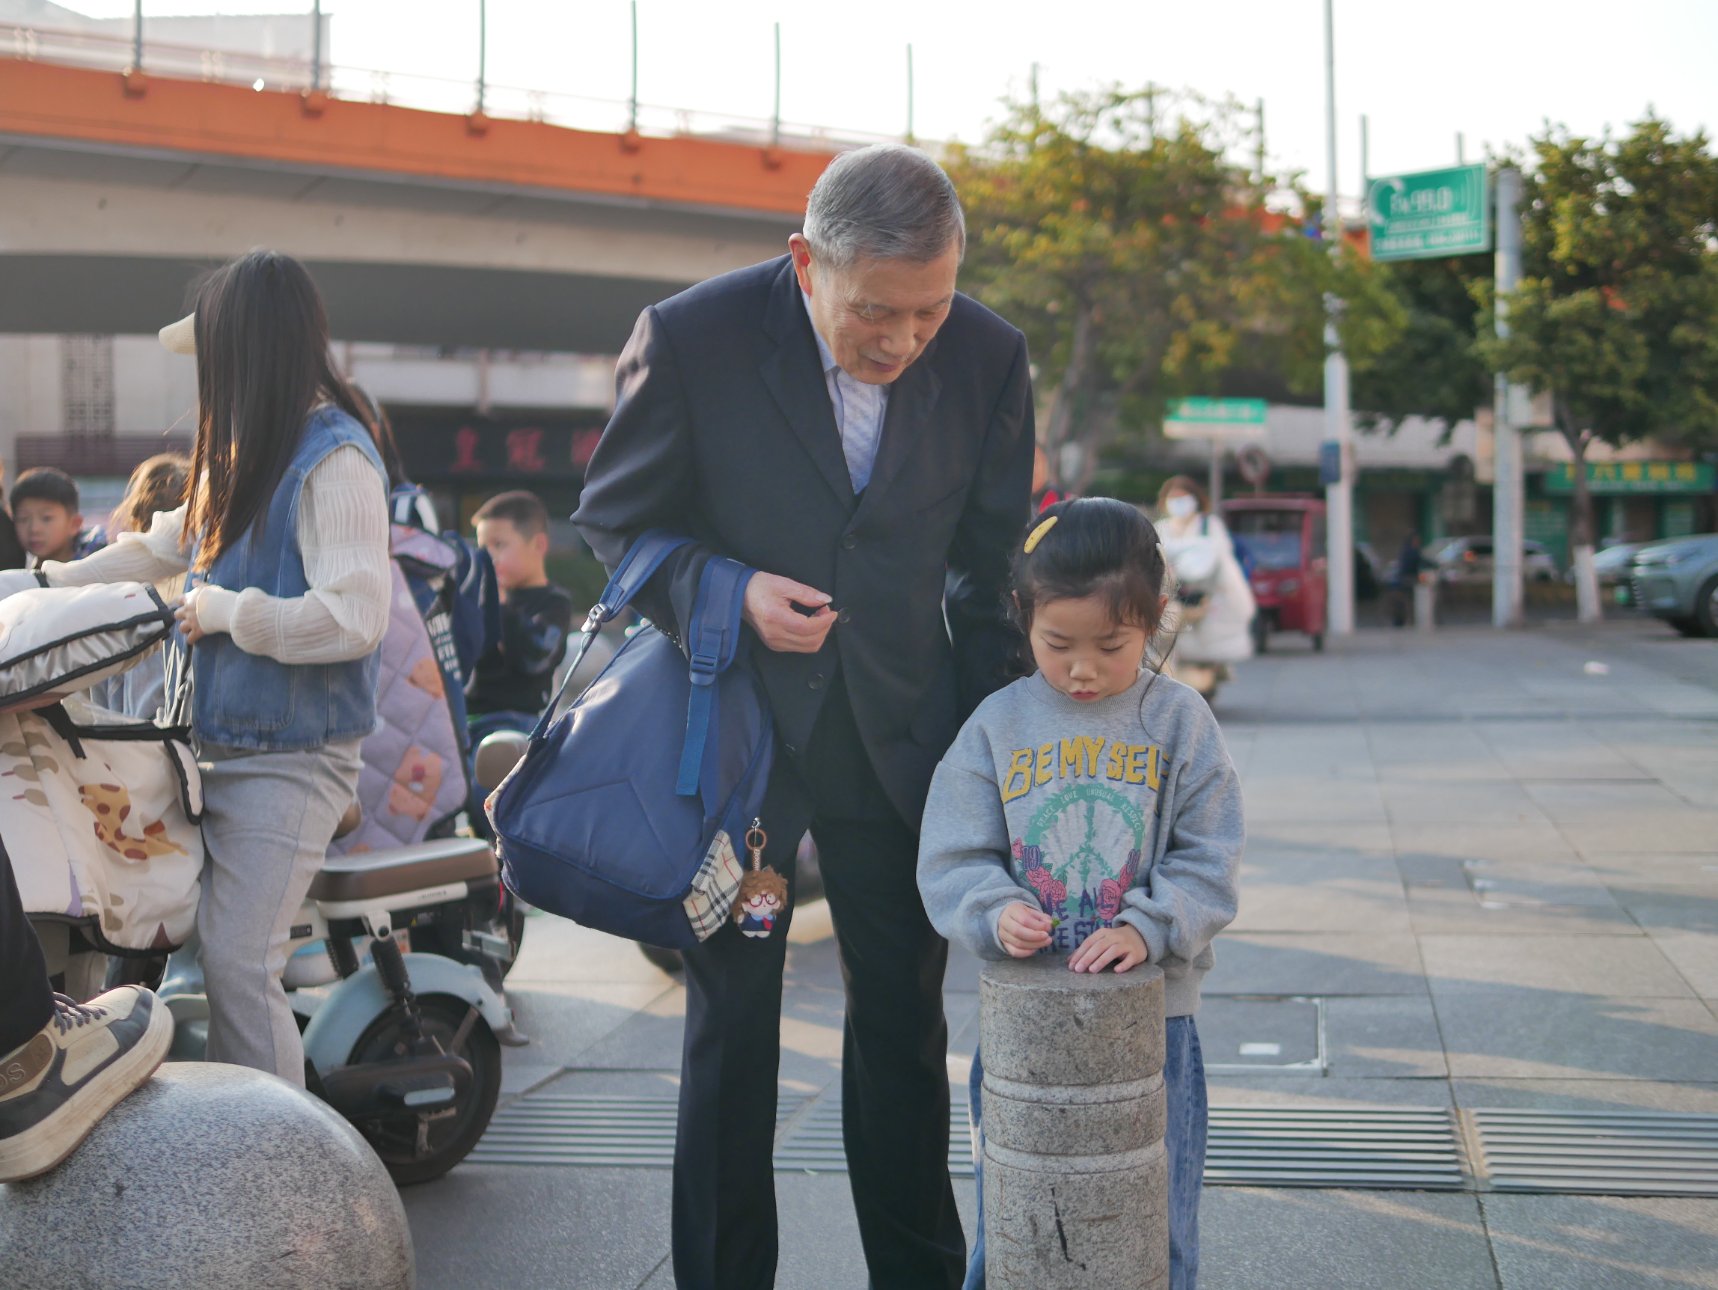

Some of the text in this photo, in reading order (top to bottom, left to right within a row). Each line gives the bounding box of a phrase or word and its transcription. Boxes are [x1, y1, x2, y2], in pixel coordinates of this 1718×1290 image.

[1002, 743, 1053, 805] BE
[1058, 735, 1105, 778] MY
[1060, 789, 1079, 805] LOVE
